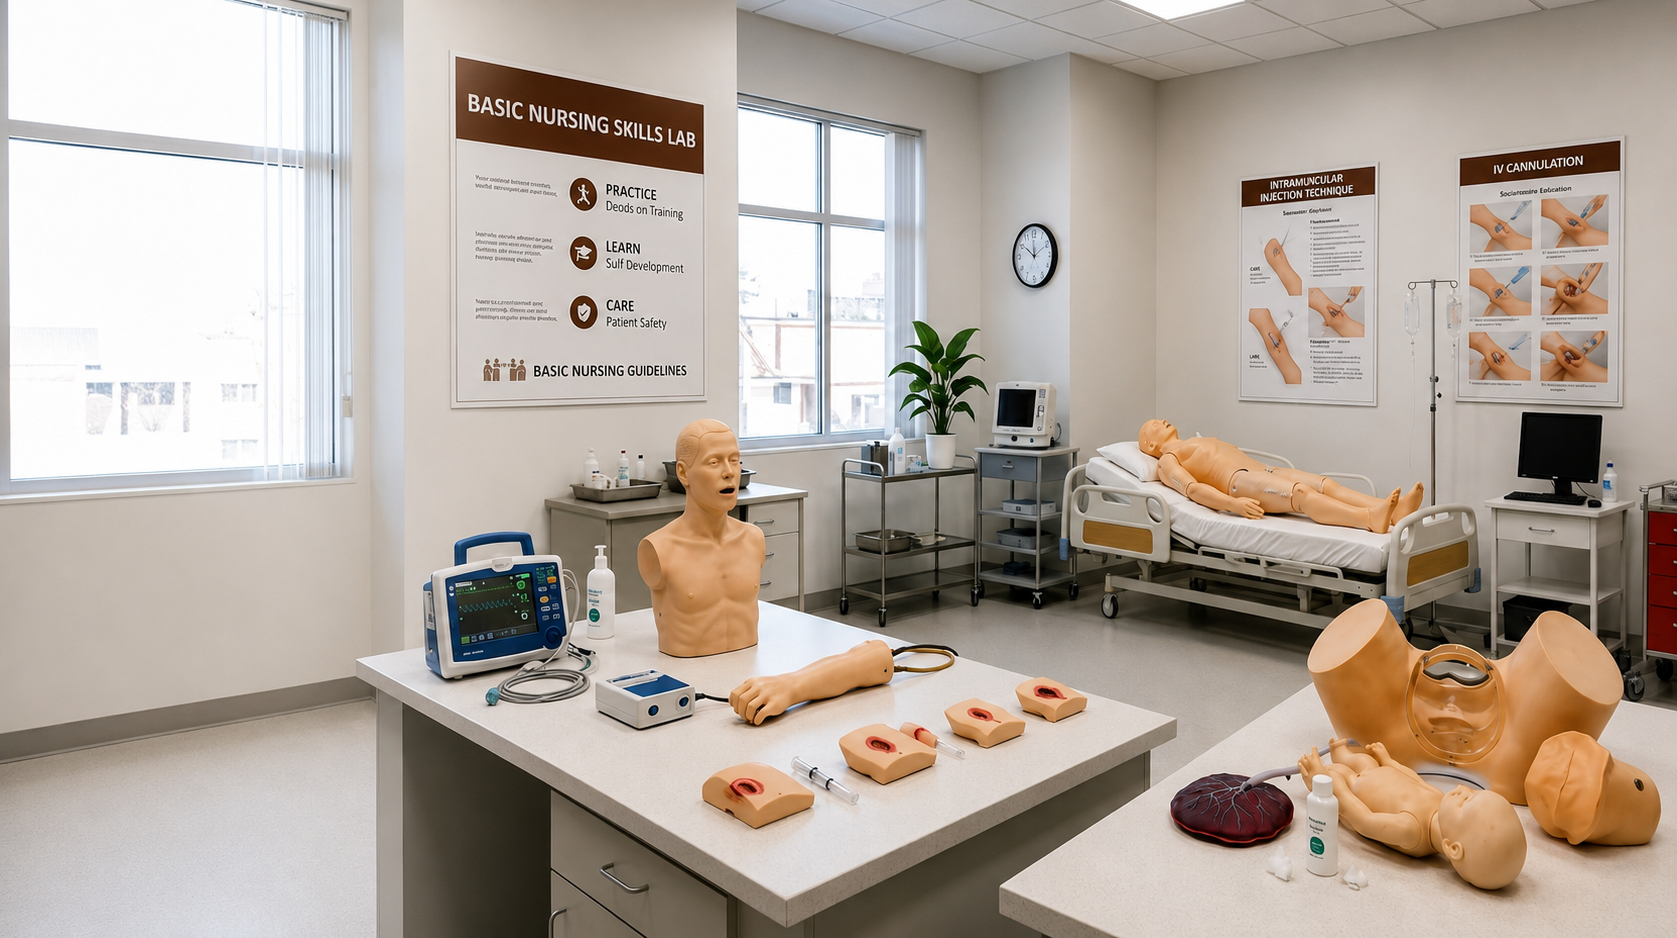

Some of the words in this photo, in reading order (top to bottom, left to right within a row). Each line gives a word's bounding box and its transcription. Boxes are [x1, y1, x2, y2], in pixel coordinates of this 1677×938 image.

[468, 93, 524, 120] BASIC
[529, 103, 610, 134] NURSING
[613, 119, 664, 143] SKILLS
[667, 128, 696, 149] LAB
[1493, 164, 1504, 175] IV
[1506, 155, 1584, 174] CANNULATION
[606, 183, 657, 201] PRACTICE
[1260, 190, 1303, 203] INJECTION
[1304, 184, 1354, 199] TECHNIQUE
[606, 201, 634, 214] Deods
[636, 206, 648, 215] on
[650, 205, 684, 222] Training
[606, 240, 641, 255] LEARN
[606, 257, 624, 270] Sulf
[626, 259, 684, 274] Development
[606, 299, 635, 312] CARE
[606, 316, 638, 328] Patient
[640, 317, 667, 330] Safety
[533, 364, 569, 378] BASIC
[572, 364, 625, 378] NURSING
[627, 364, 687, 377] GUIDELINES
